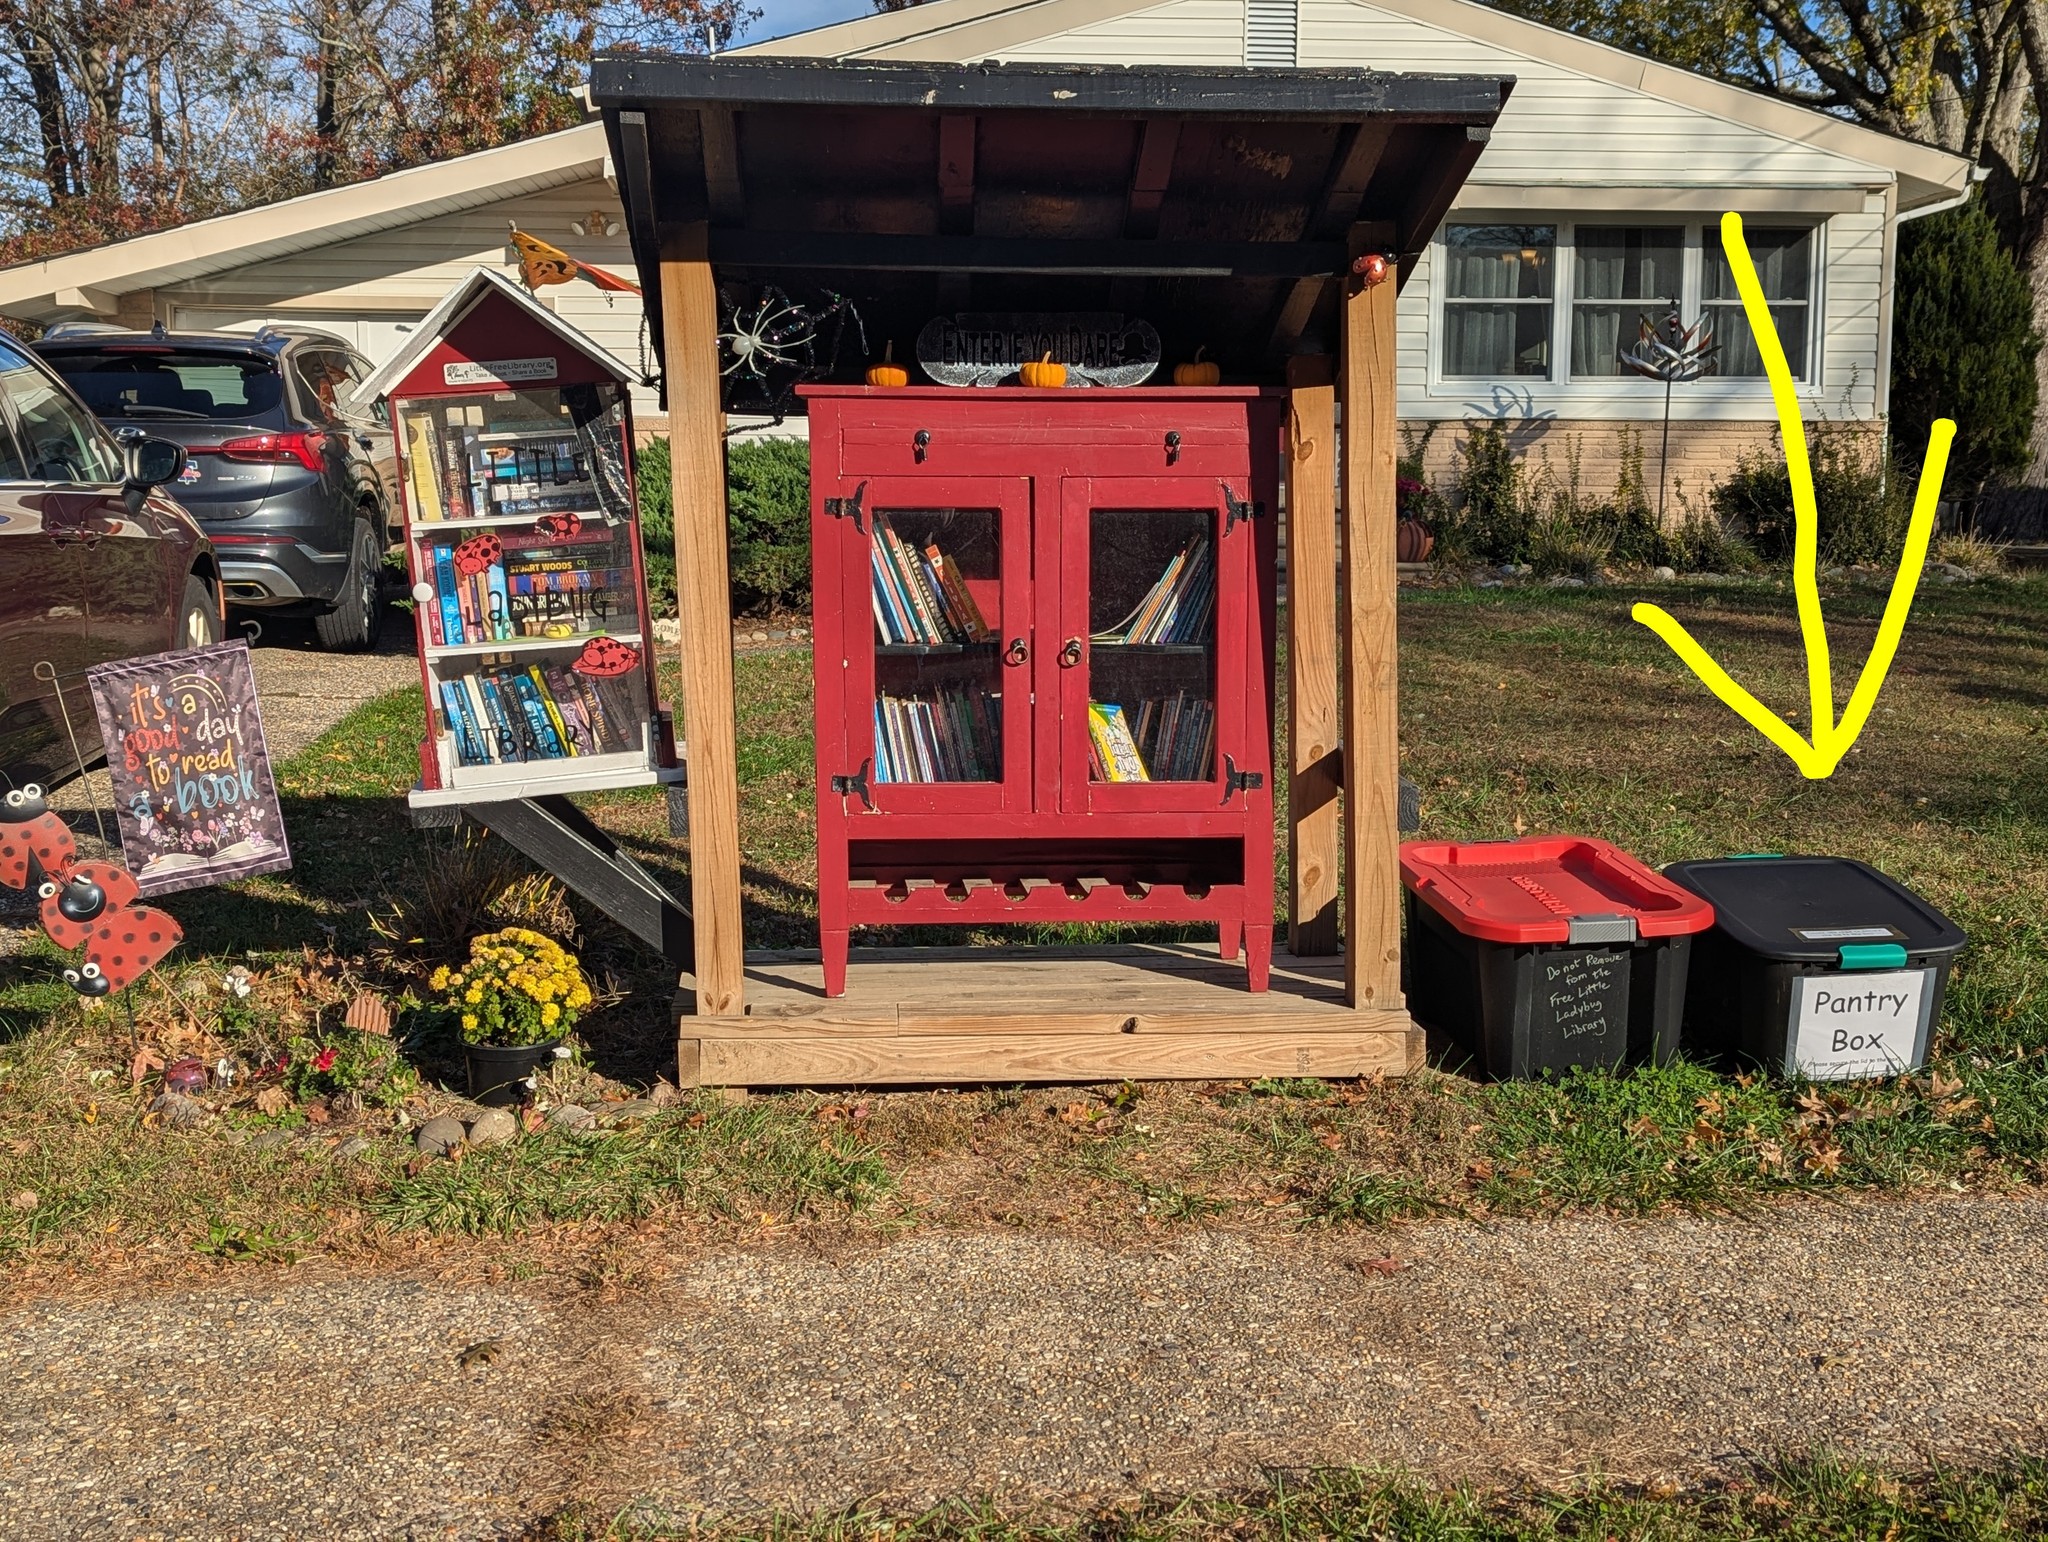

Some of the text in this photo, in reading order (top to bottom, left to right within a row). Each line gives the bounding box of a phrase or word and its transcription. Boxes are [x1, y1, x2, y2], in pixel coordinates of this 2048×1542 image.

[942, 324, 1119, 368] ENTER IF YOU DARE
[469, 361, 551, 372] LittleFreeLibrary.org
[467, 446, 590, 488] LITTLE
[509, 561, 573, 573] STUART WOODS
[532, 572, 599, 586] TOM BROKAW
[129, 683, 197, 728] it's a
[123, 707, 244, 772] good day
[145, 739, 236, 793] to read
[129, 755, 260, 820] a book
[1546, 953, 1624, 981] Do not Remove
[1592, 967, 1612, 980] the
[1550, 981, 1611, 1008] Free Little
[1814, 990, 1909, 1017] Pantry
[1556, 1000, 1603, 1023] Ladybug
[1563, 1016, 1607, 1039] Library
[1831, 1029, 1884, 1053] Box
